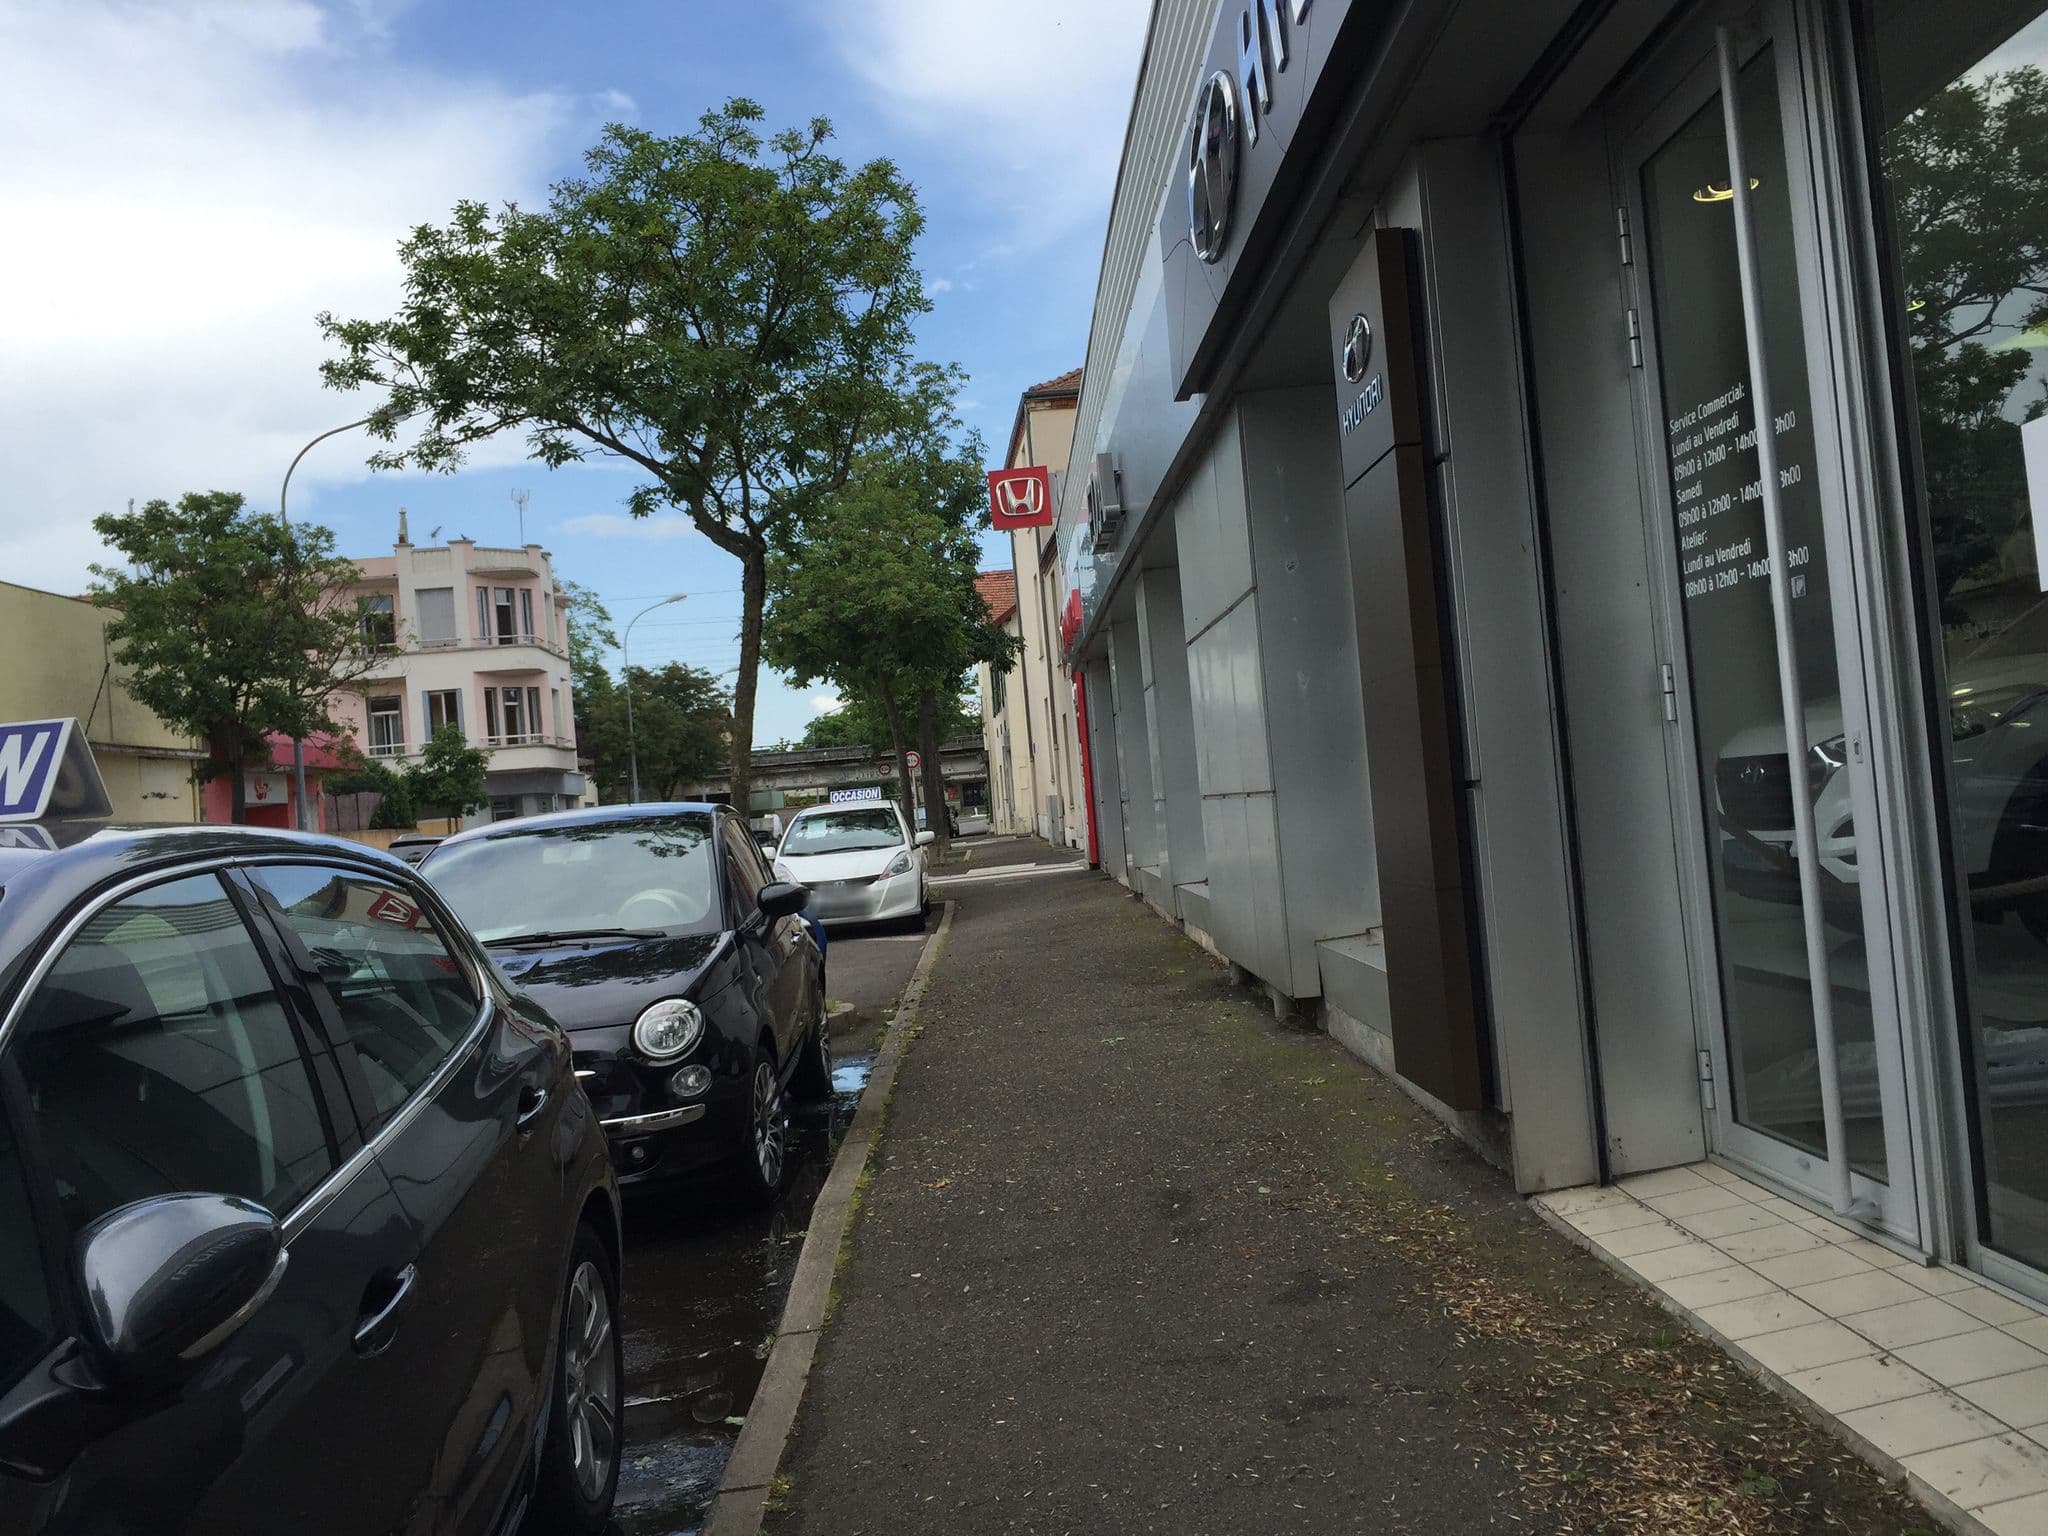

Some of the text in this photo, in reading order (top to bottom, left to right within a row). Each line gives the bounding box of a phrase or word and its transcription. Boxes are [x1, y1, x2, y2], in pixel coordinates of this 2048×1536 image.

[1342, 373, 1384, 436] HYUNDAI
[1669, 382, 1745, 435] Service Commercial:
[1672, 411, 1739, 458] Lundi au Vendredi
[1674, 458, 1696, 481] 09h00
[1703, 443, 1726, 467] 12h00
[1676, 480, 1703, 505] Samedi
[1678, 505, 1700, 528] 09h00
[1708, 493, 1731, 516] 12h00
[1683, 537, 1752, 575] Lundi au Vendredi
[1685, 577, 1707, 598] 08h00
[1715, 567, 1738, 589] 12h00
[832, 788, 878, 802] OCCASION
